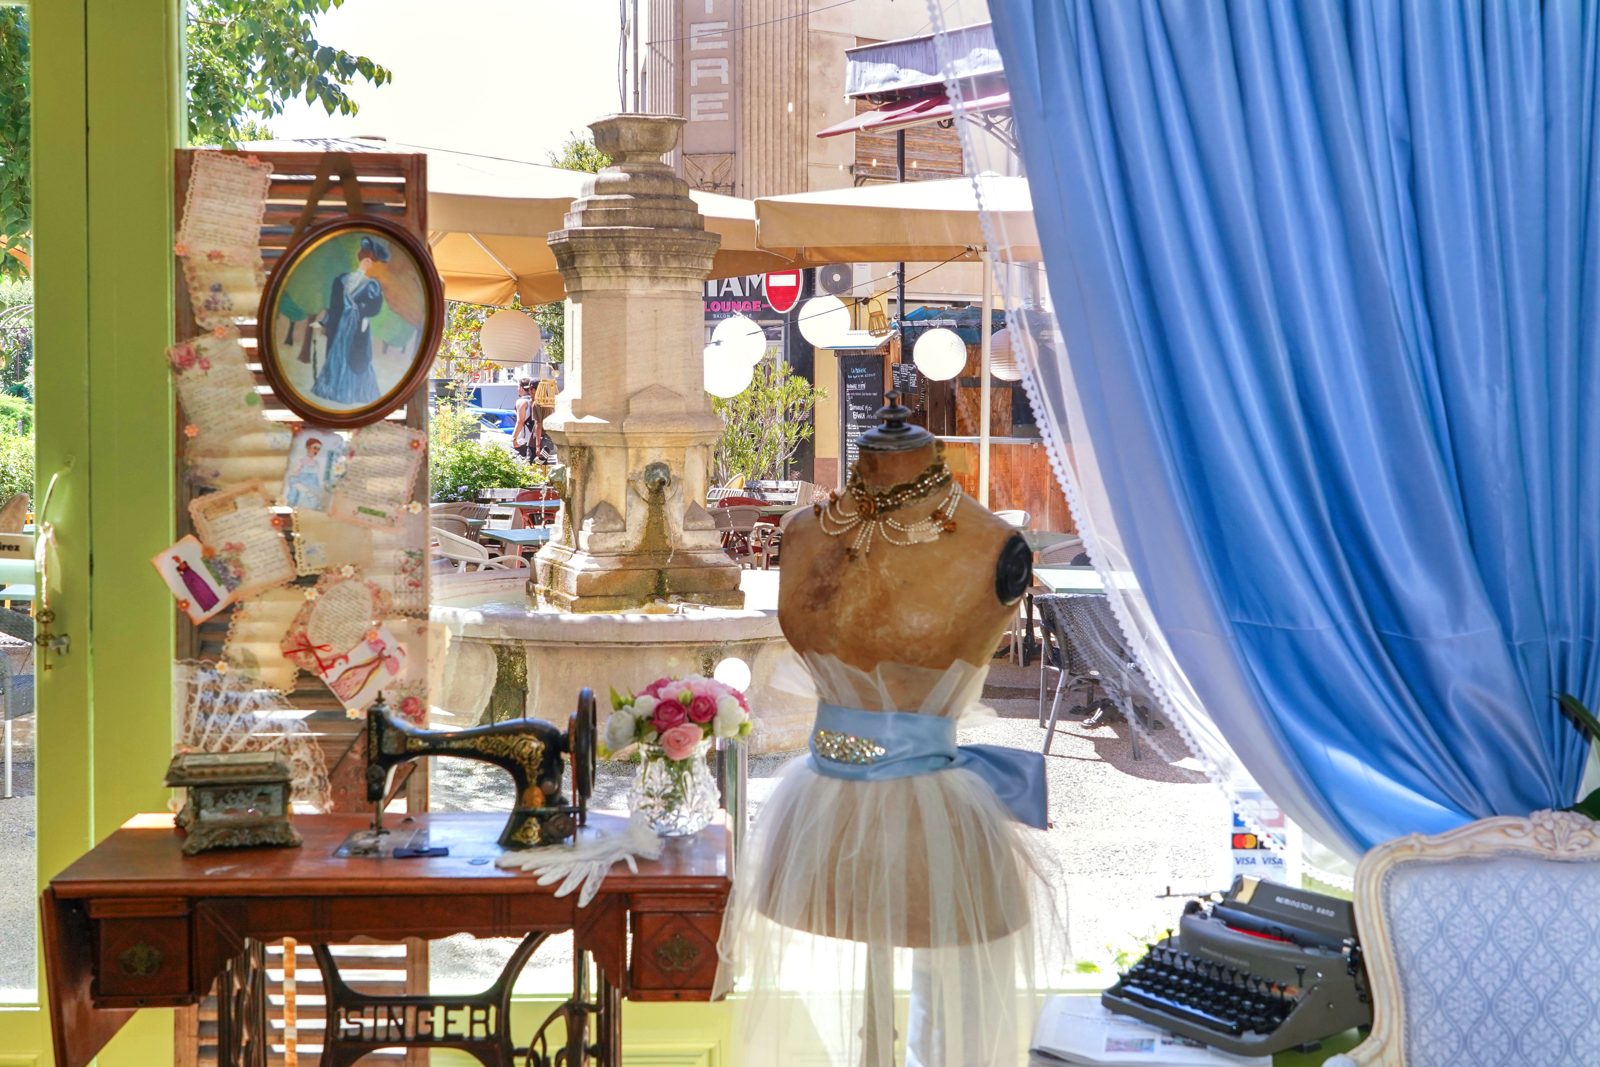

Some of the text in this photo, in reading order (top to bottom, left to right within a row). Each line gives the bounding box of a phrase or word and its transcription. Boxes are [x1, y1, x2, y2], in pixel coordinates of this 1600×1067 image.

[702, 273, 767, 297] IAM
[704, 300, 762, 312] LOUNGE
[1235, 857, 1283, 865] VISA VISA
[344, 1005, 496, 1041] SINGER
